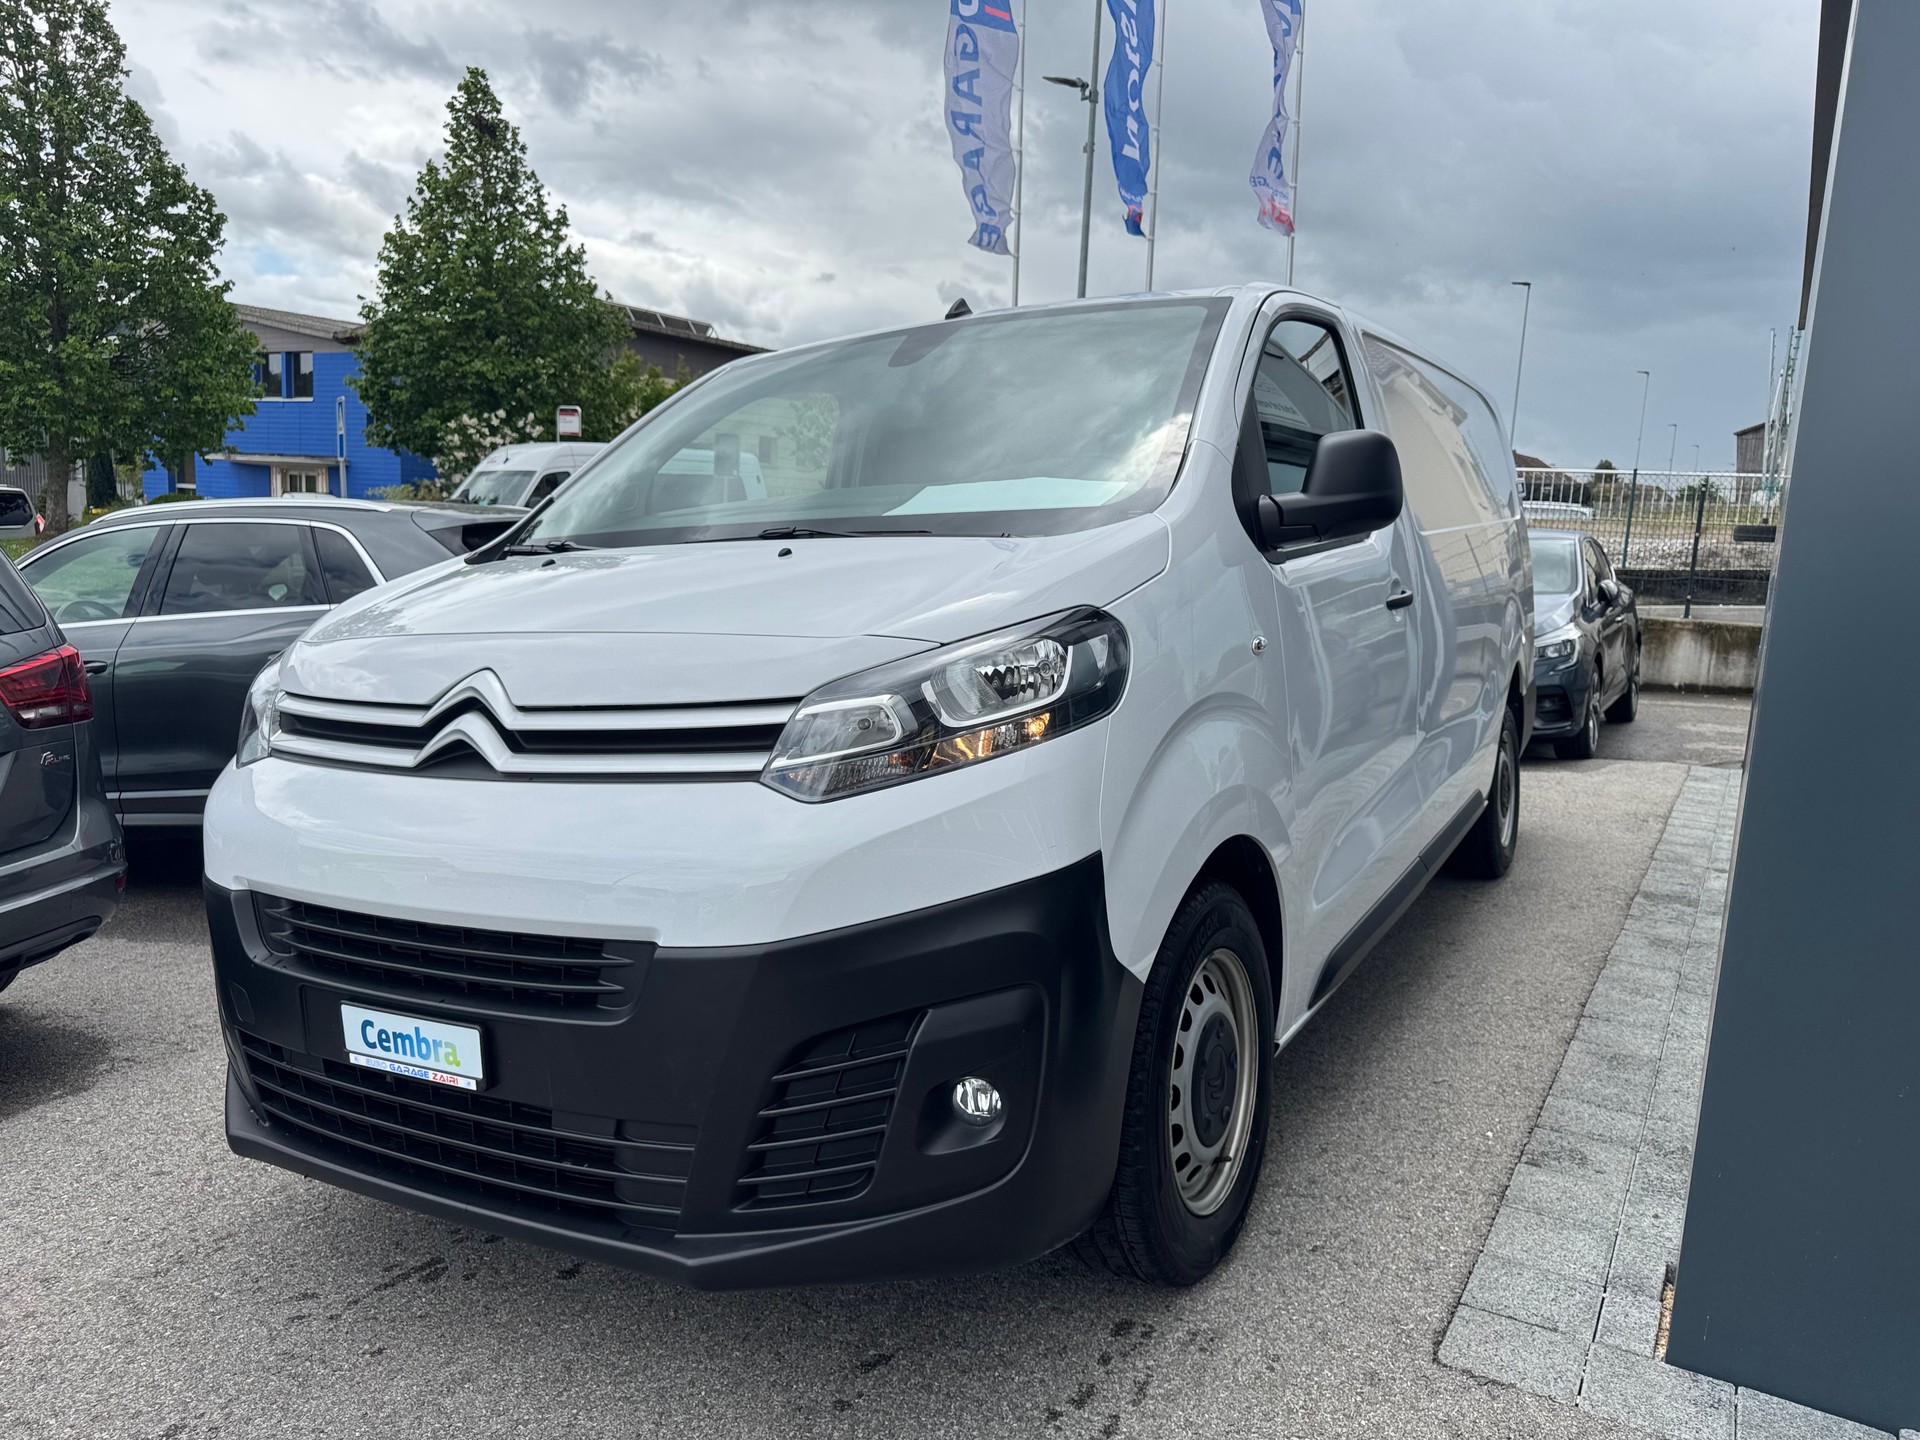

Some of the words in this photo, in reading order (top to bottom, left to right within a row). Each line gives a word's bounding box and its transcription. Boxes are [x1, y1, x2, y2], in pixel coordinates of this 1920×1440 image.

[361, 1019, 461, 1068] Cembra
[365, 1058, 388, 1070] EURO
[389, 1064, 430, 1079] GARAGE
[432, 1072, 459, 1086] ZAIRI
